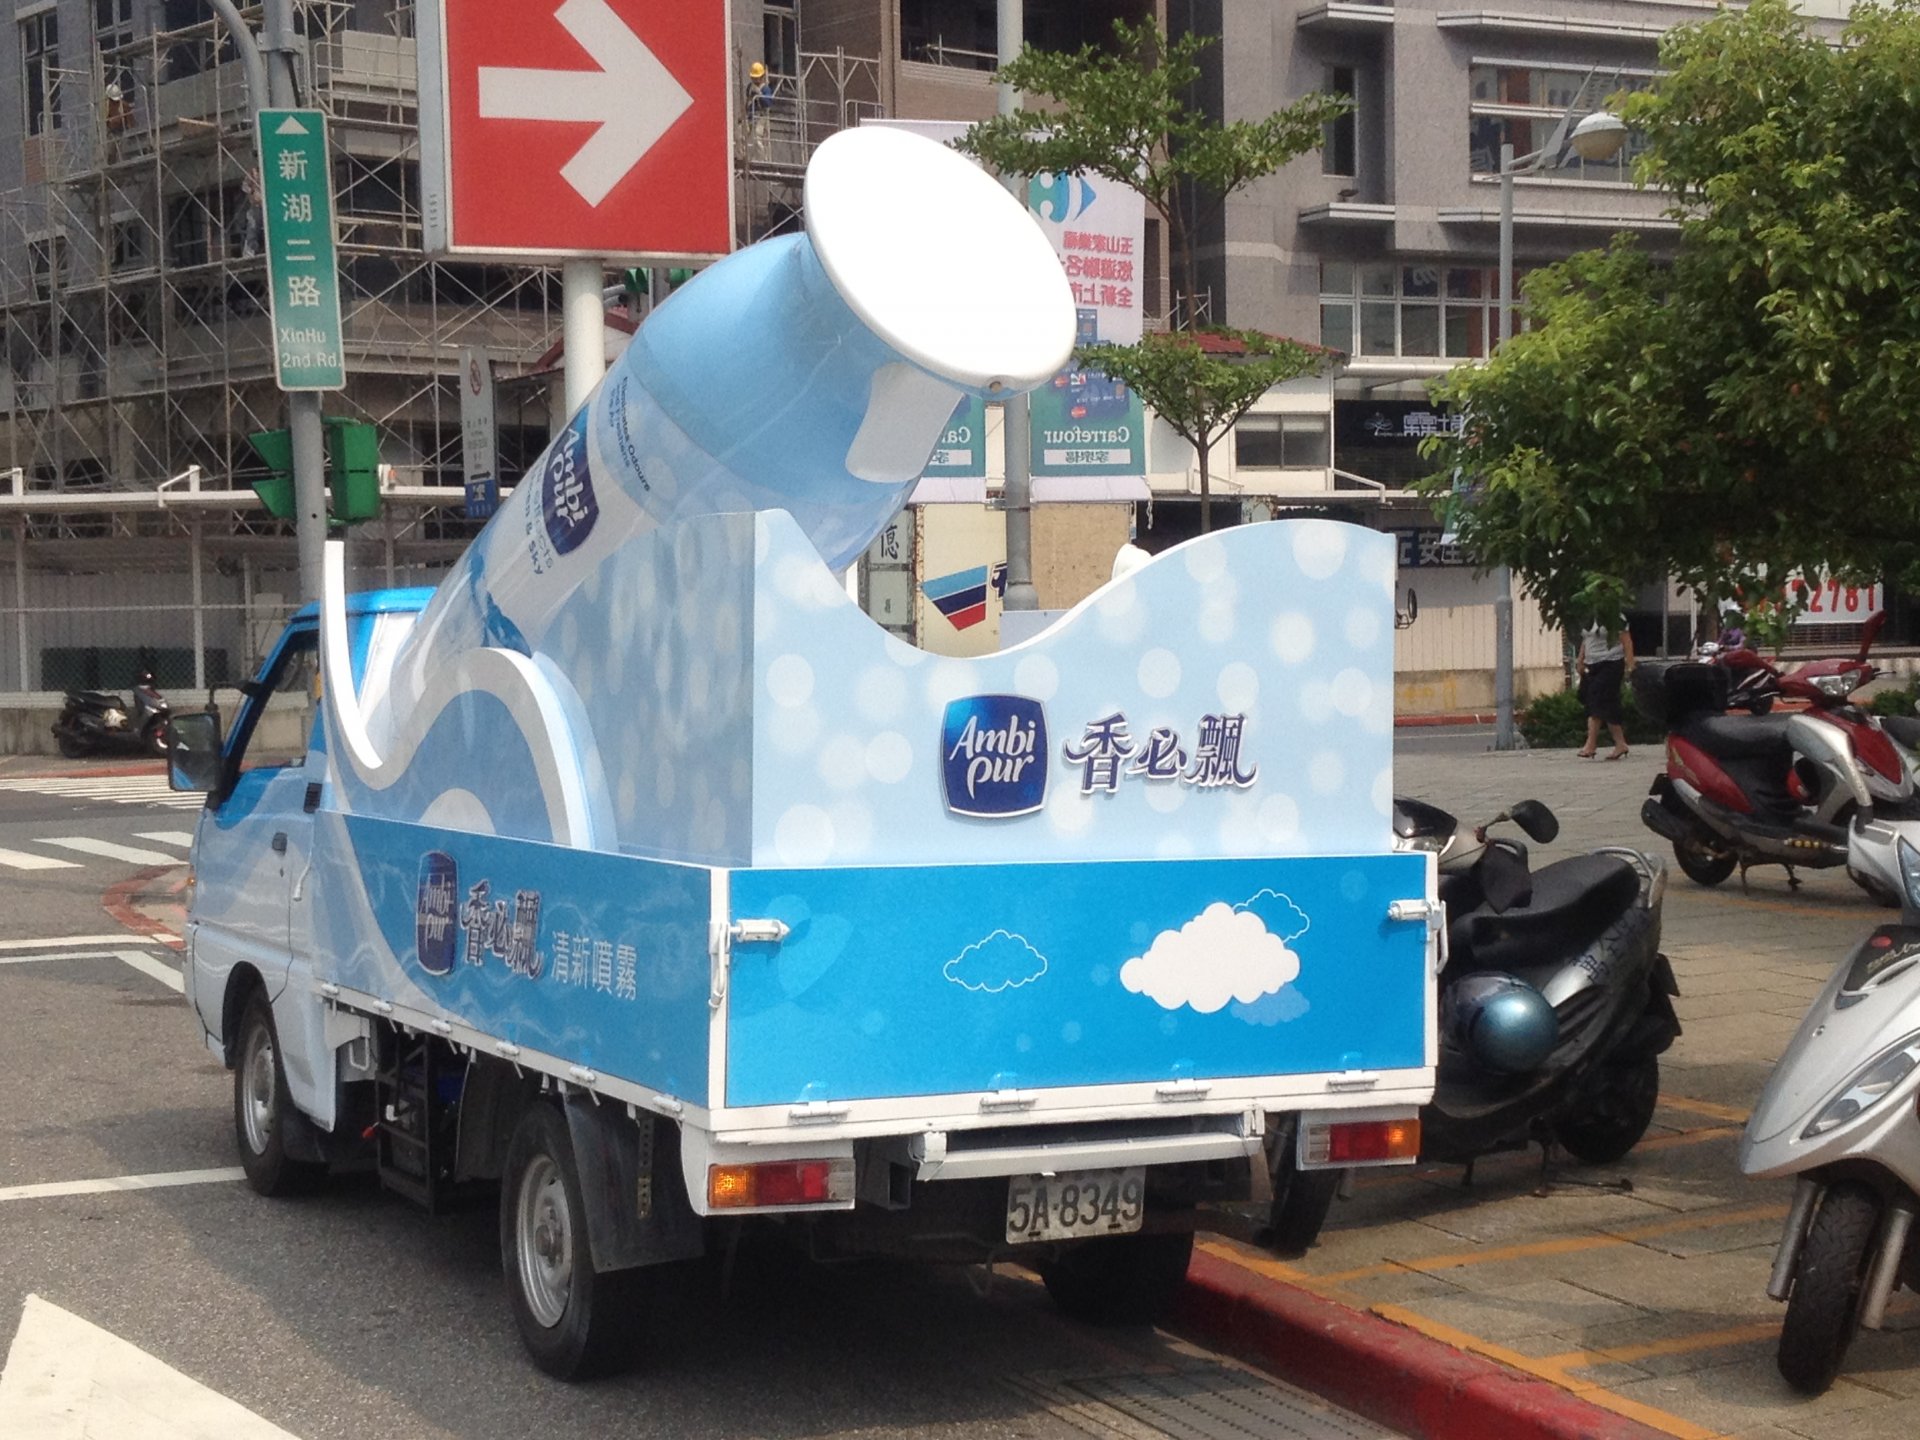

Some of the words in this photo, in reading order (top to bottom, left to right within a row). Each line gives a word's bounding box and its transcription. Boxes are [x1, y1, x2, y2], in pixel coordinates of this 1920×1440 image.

[278, 148, 322, 307] 新湖二路
[280, 328, 327, 344] XinHu
[550, 453, 575, 528] pur
[564, 428, 588, 522] Ambi
[628, 444, 651, 492] Odours
[529, 540, 544, 575] Sky
[949, 714, 1036, 761] Ambi
[1061, 711, 1258, 794] 香必飄
[966, 754, 1035, 800] pur
[420, 873, 454, 914] Ambi
[460, 879, 544, 980] 香必飄
[551, 930, 637, 1001] 清新噴霧
